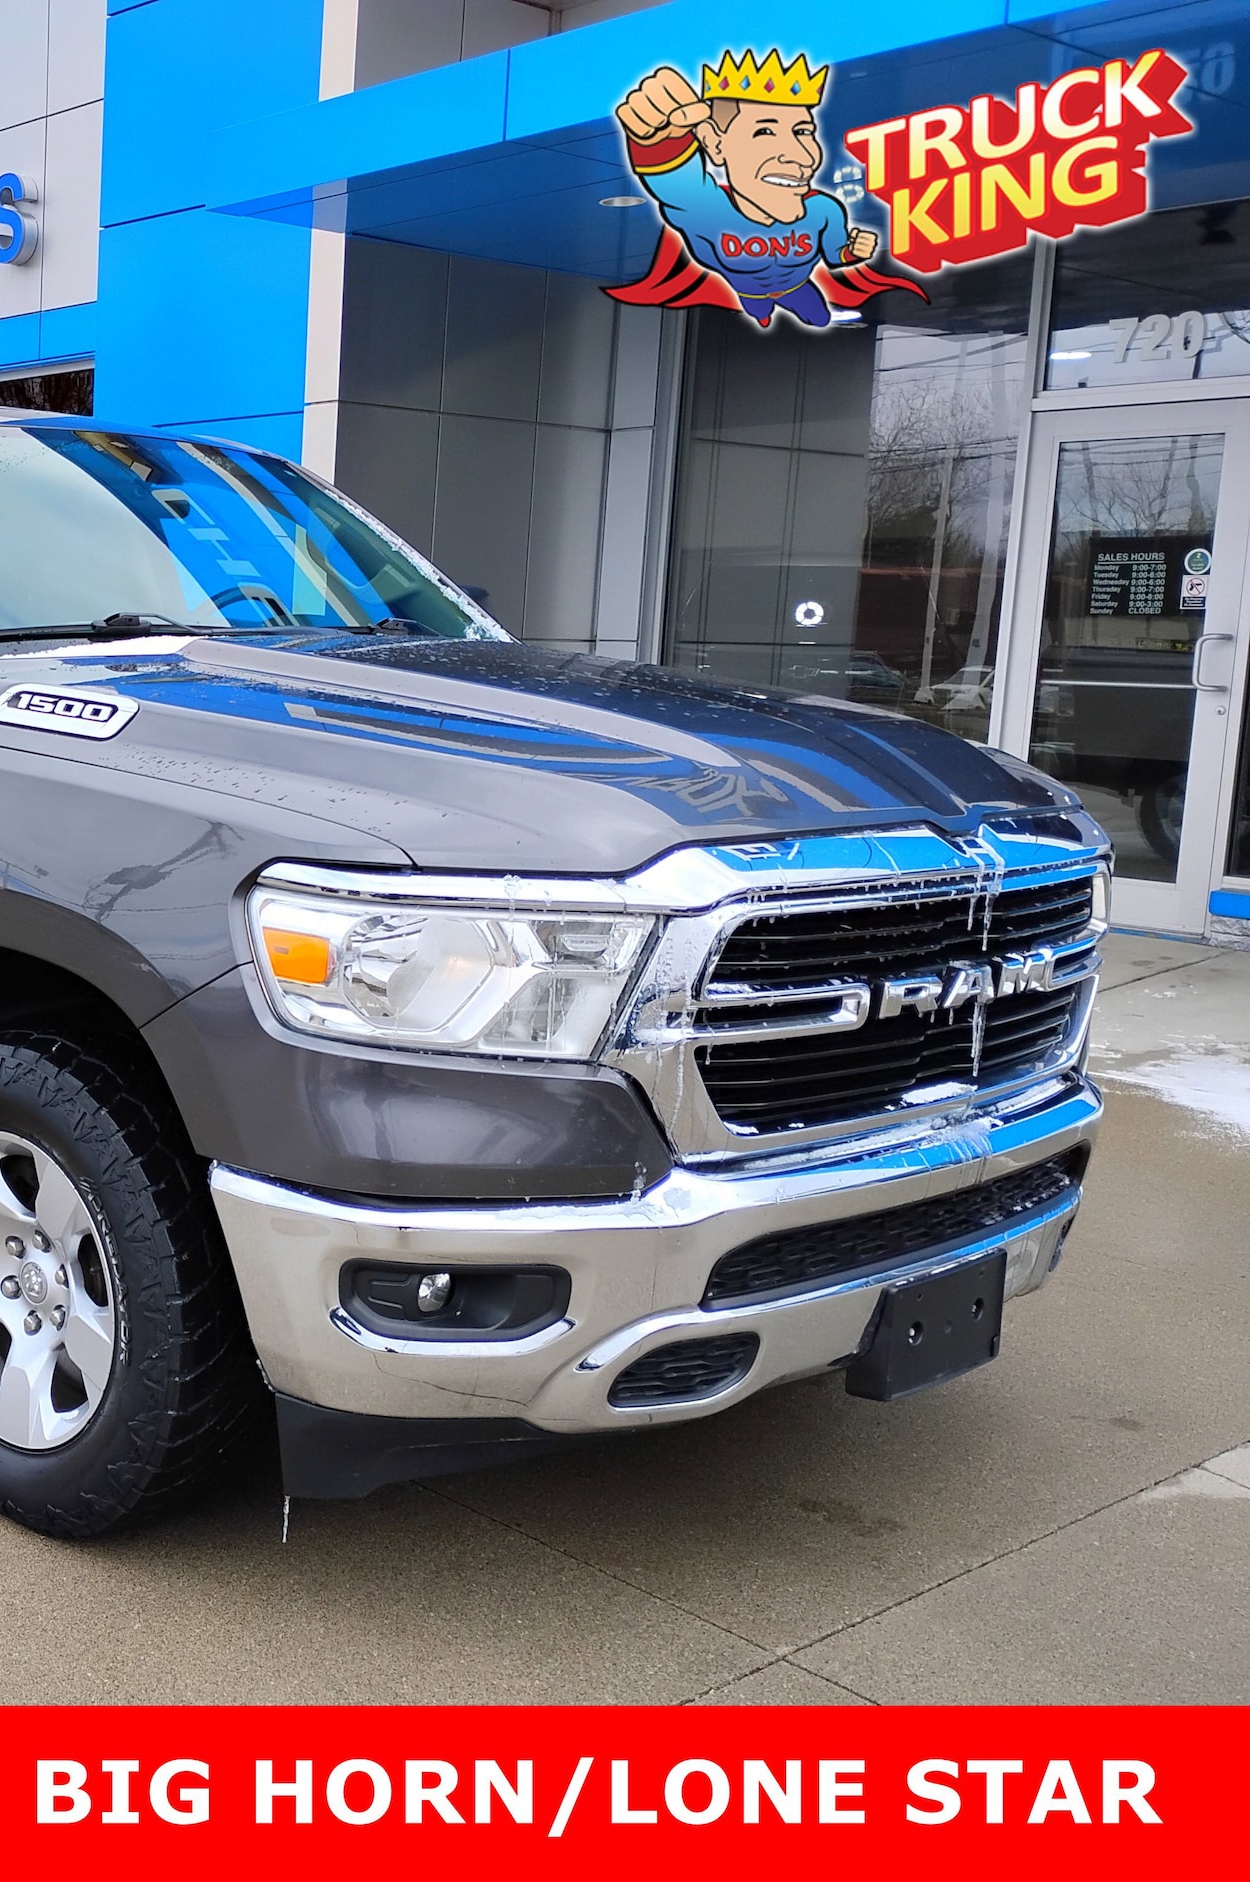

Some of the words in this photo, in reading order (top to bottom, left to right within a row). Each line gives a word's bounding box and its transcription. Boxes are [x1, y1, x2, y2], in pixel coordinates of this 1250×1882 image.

[1108, 310, 1205, 364] 720
[1097, 552, 1129, 561] SALES
[1130, 552, 1165, 561] HOURS
[1093, 571, 1119, 579] Tuesday
[1091, 593, 1111, 601] Friday
[1090, 600, 1119, 608] Saturday
[1089, 607, 1114, 615] Sunday
[17, 693, 114, 721] 1500
[878, 951, 1053, 1020] RAM
